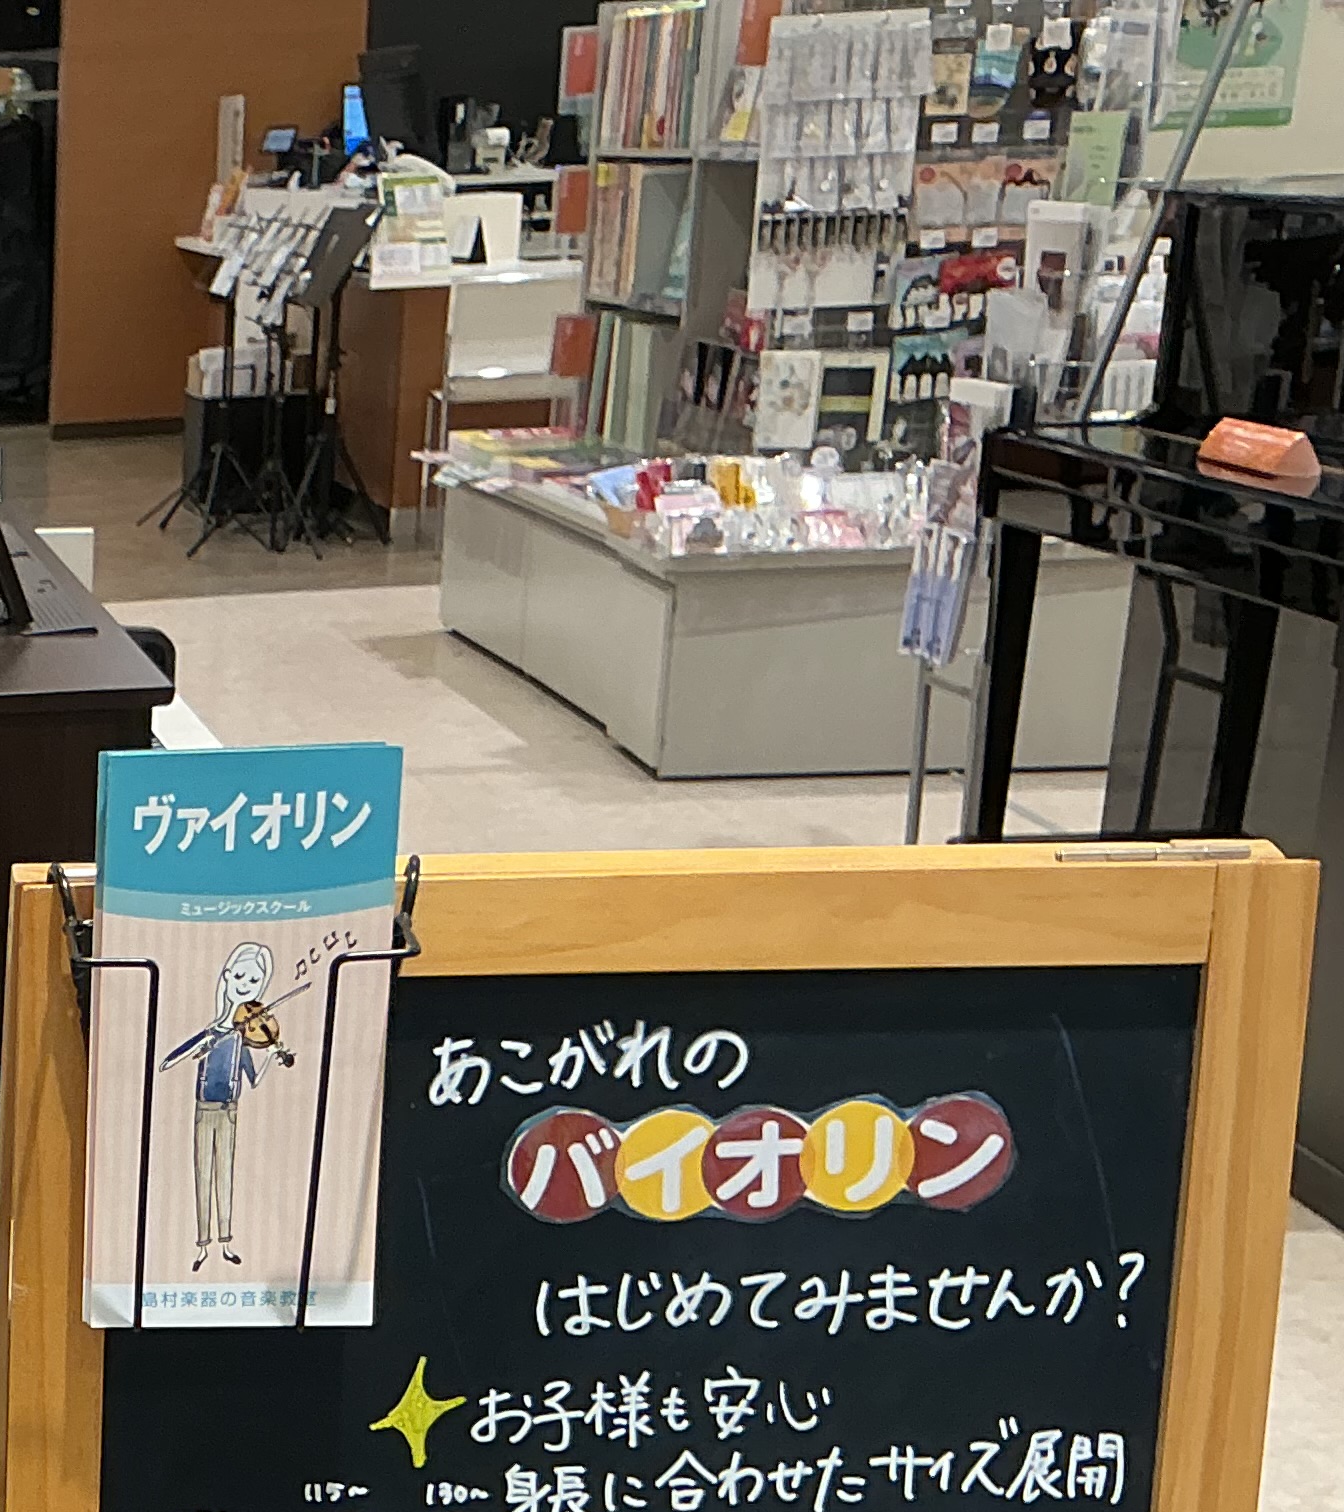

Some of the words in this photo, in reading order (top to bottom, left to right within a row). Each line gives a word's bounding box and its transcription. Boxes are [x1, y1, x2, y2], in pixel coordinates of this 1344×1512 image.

[133, 790, 372, 855] ヴァイオリン
[180, 898, 311, 917] ミュージックスクール
[428, 1016, 749, 1106] あこがれの
[522, 1110, 1007, 1214] バイオリン
[533, 1252, 1149, 1336] はじめてみませんか?
[470, 1366, 833, 1452] お子様も安心
